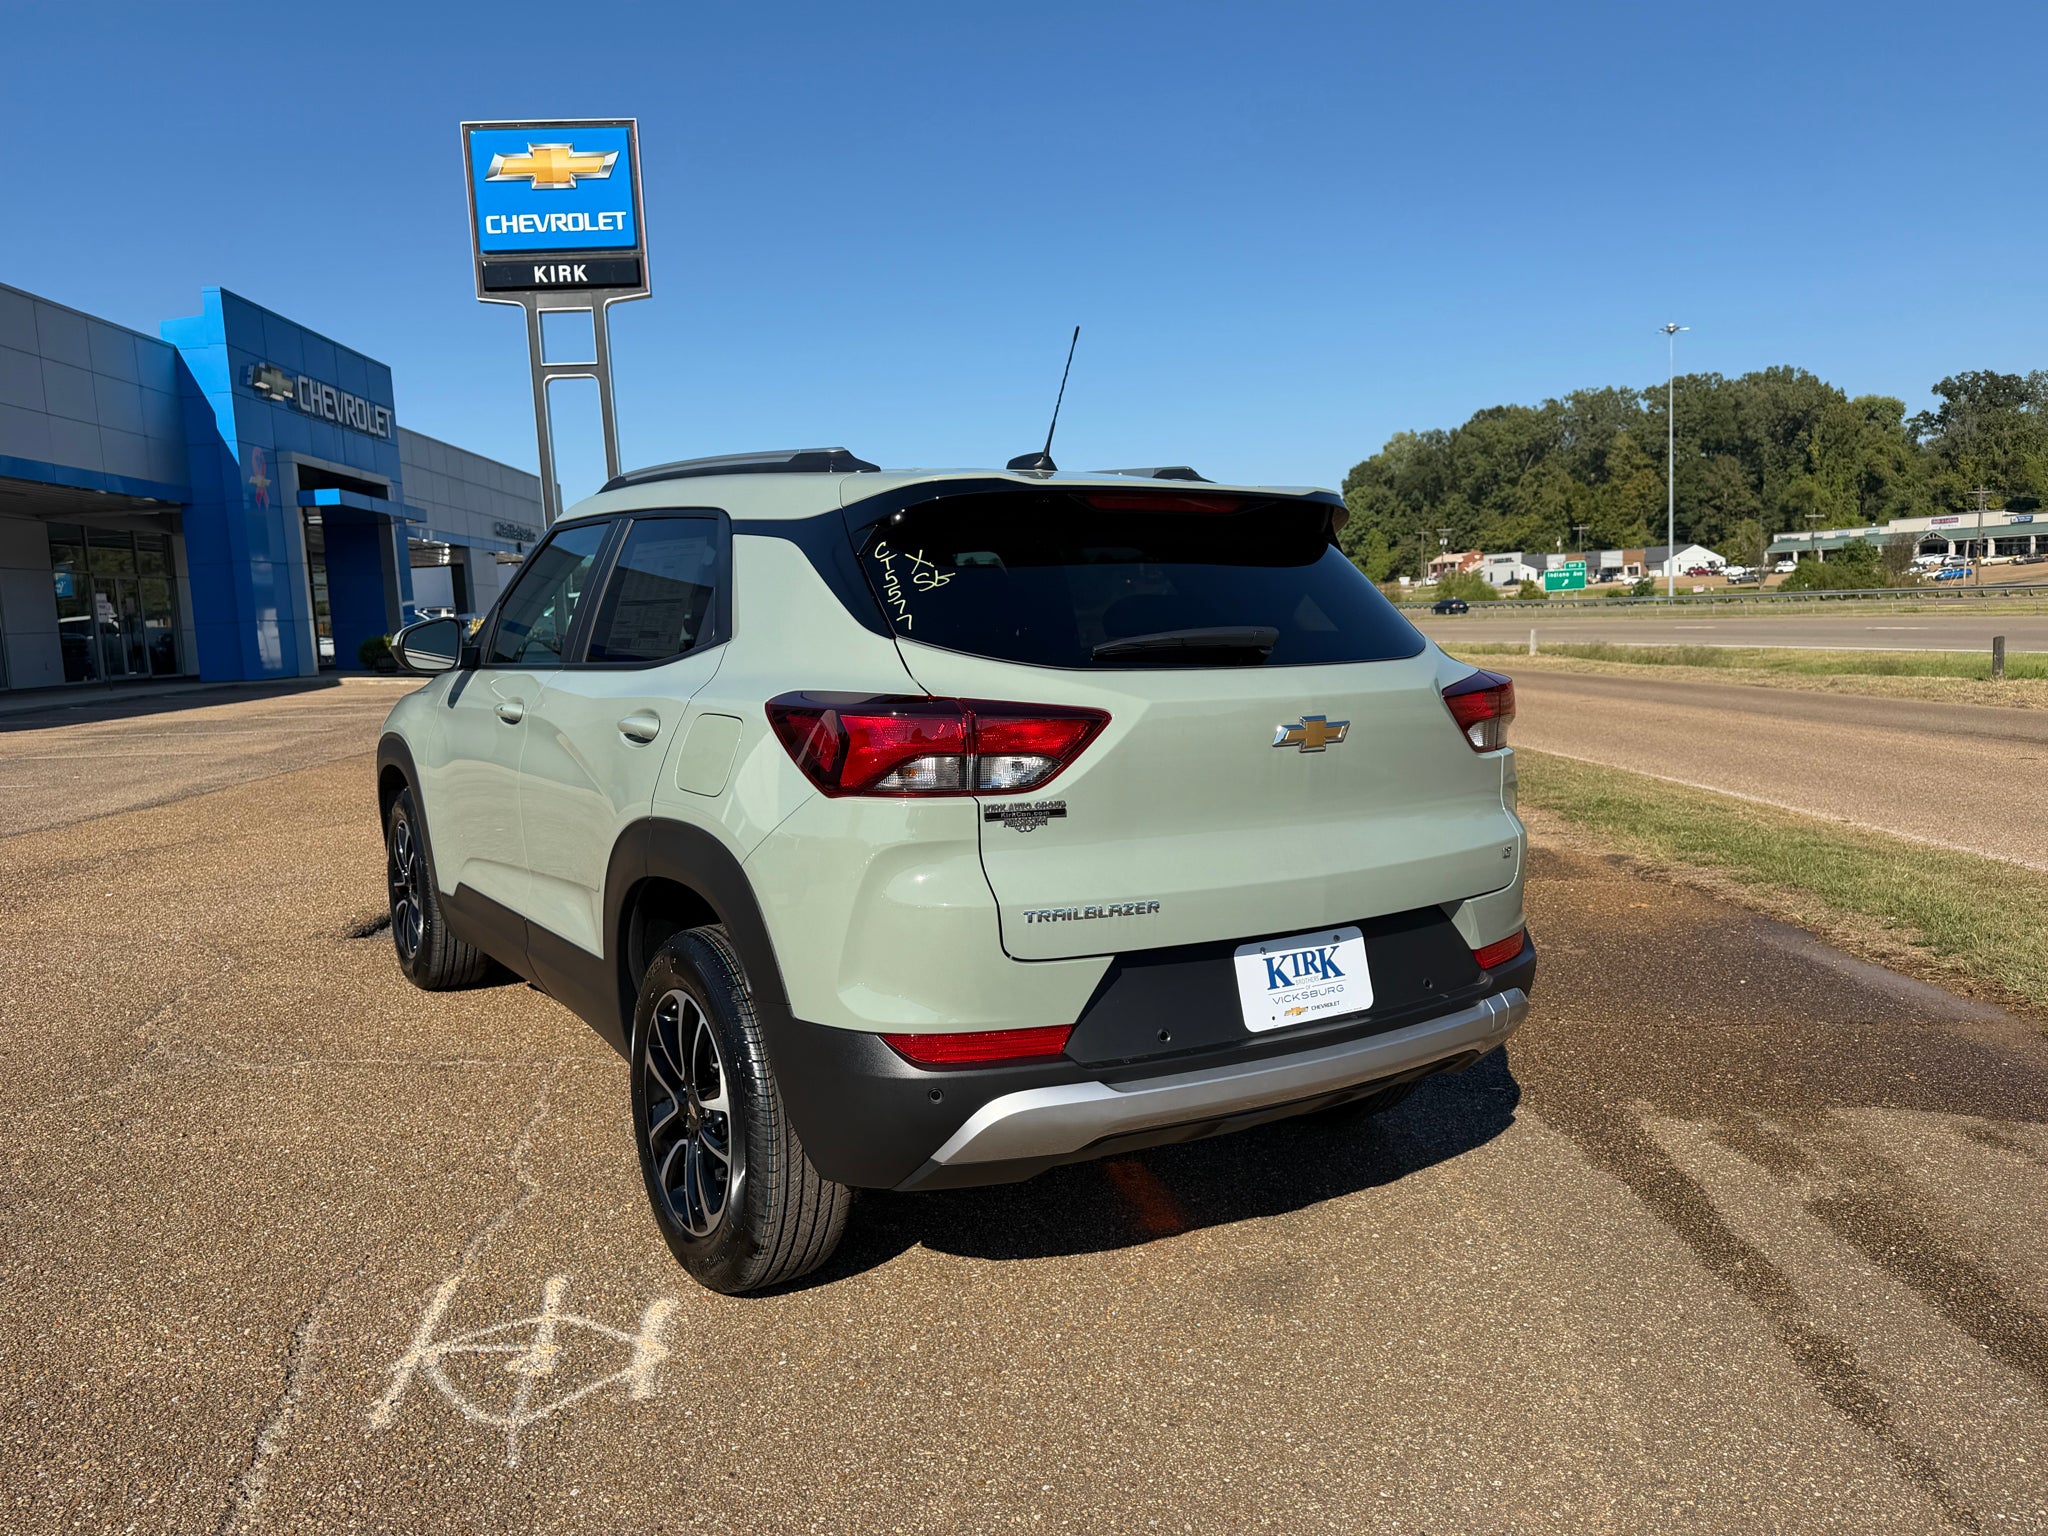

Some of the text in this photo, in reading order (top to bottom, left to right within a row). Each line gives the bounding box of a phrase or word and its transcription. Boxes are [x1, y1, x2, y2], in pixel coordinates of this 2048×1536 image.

[485, 211, 627, 234] CHEVROLET
[533, 264, 589, 283] KIRK
[297, 375, 392, 439] CHEVROLET
[1023, 900, 1161, 924] TRAILBLAZER
[1262, 945, 1346, 991] KIRK
[1272, 984, 1345, 1005] VICKSBURG
[1310, 1000, 1340, 1011] CHEVROLET
